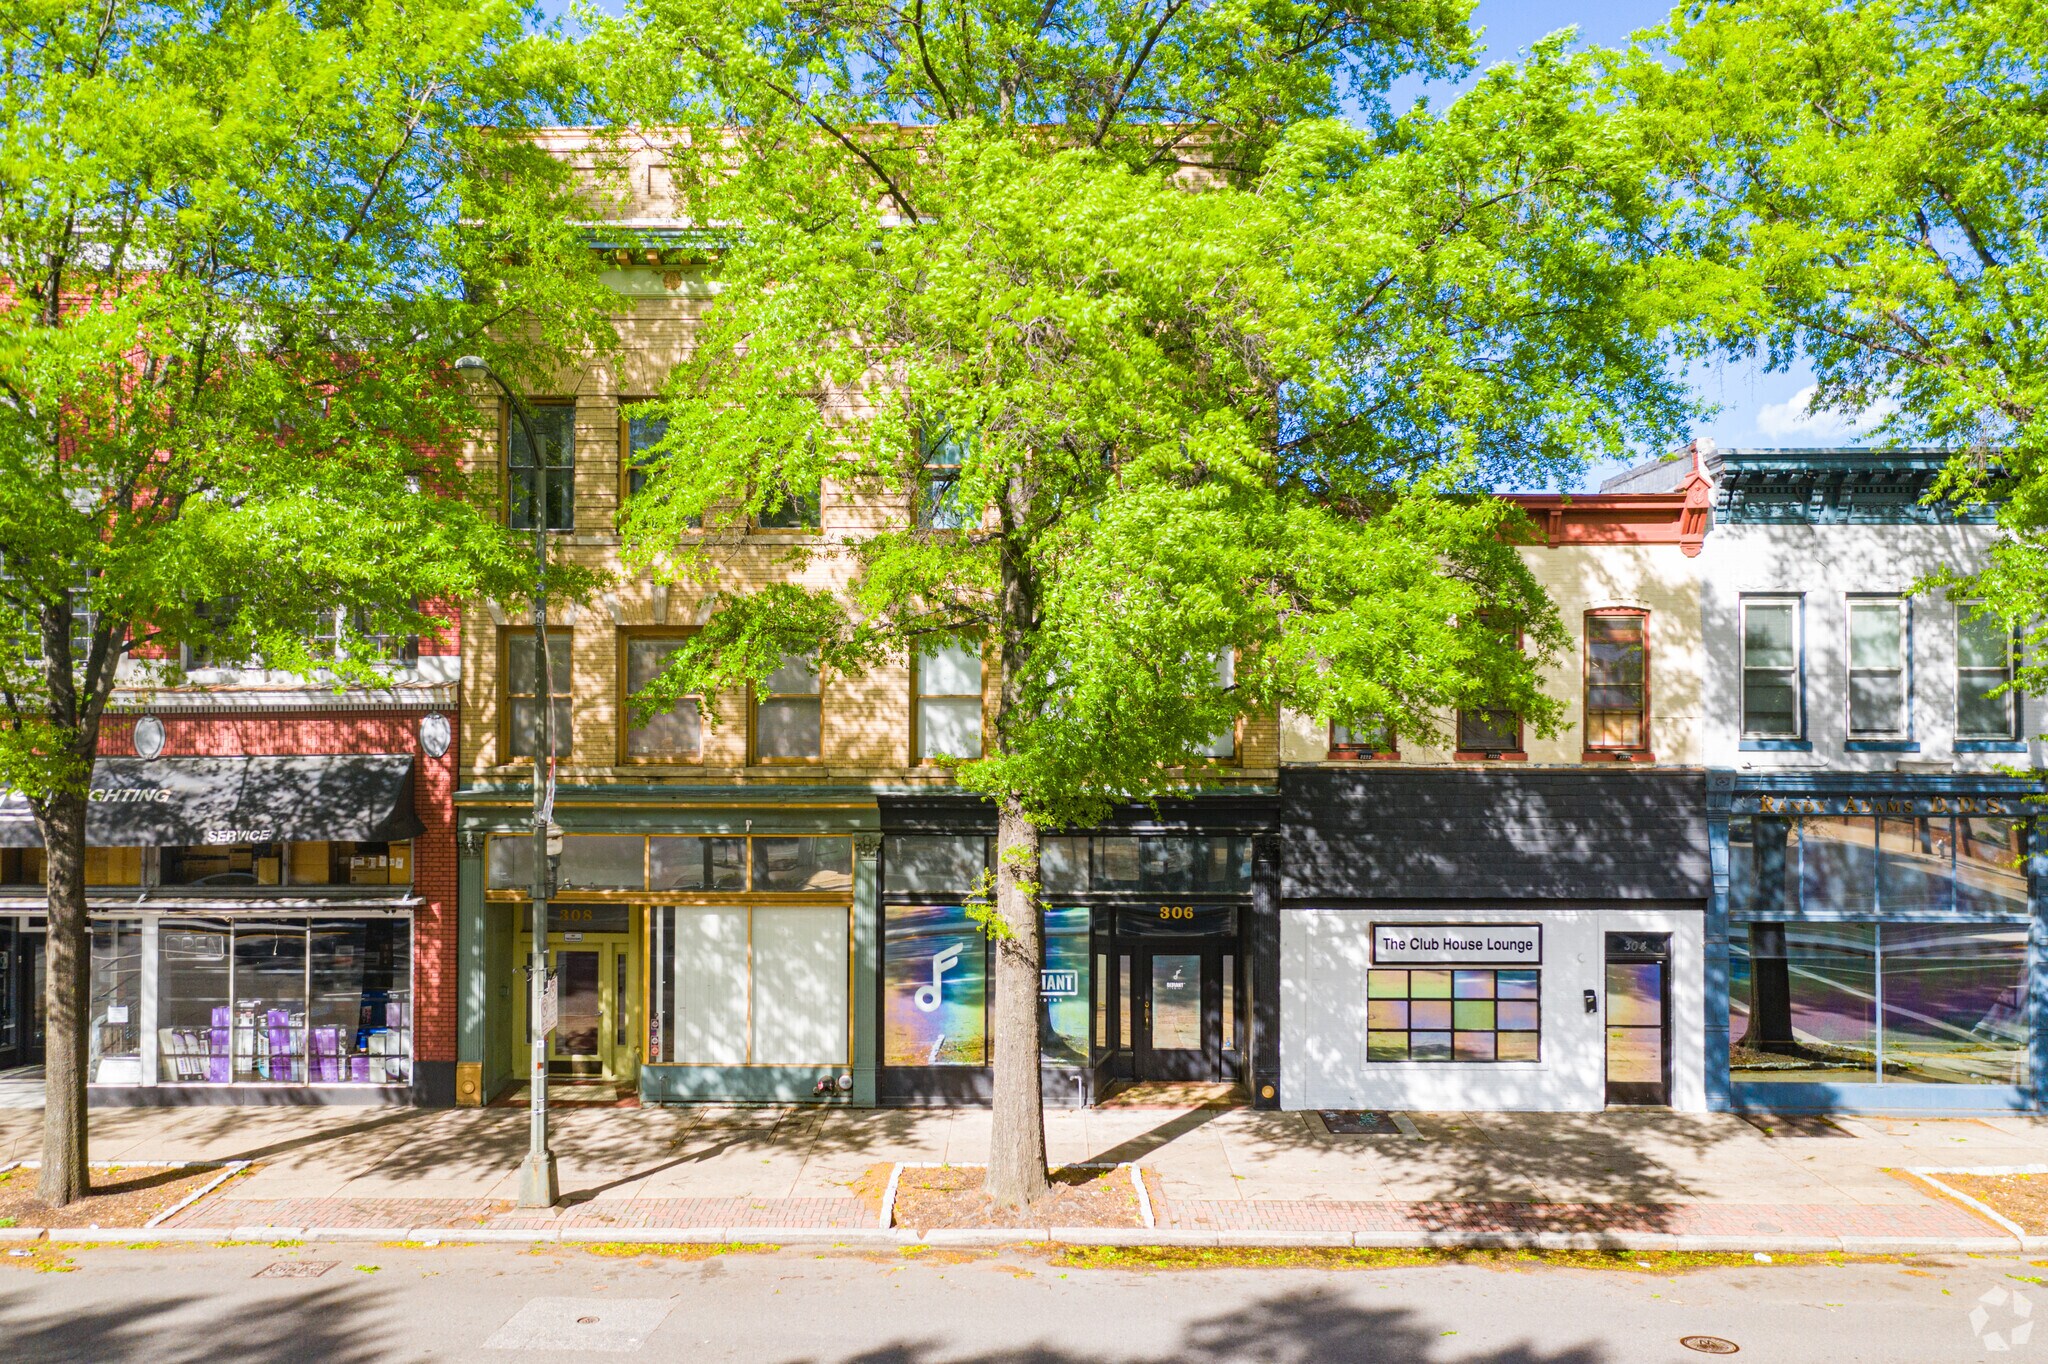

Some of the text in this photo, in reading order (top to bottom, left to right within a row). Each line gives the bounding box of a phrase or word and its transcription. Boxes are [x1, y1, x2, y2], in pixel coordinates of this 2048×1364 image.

[87, 788, 171, 803] GHTING
[1759, 796, 1826, 814] RANDY
[1843, 796, 1913, 814] ADAMS
[207, 829, 271, 843] SERVICE
[560, 909, 593, 921] 308
[1160, 906, 1194, 919] 306
[1383, 937, 1533, 954] The Club House Lounge
[1041, 974, 1074, 990] IANT
